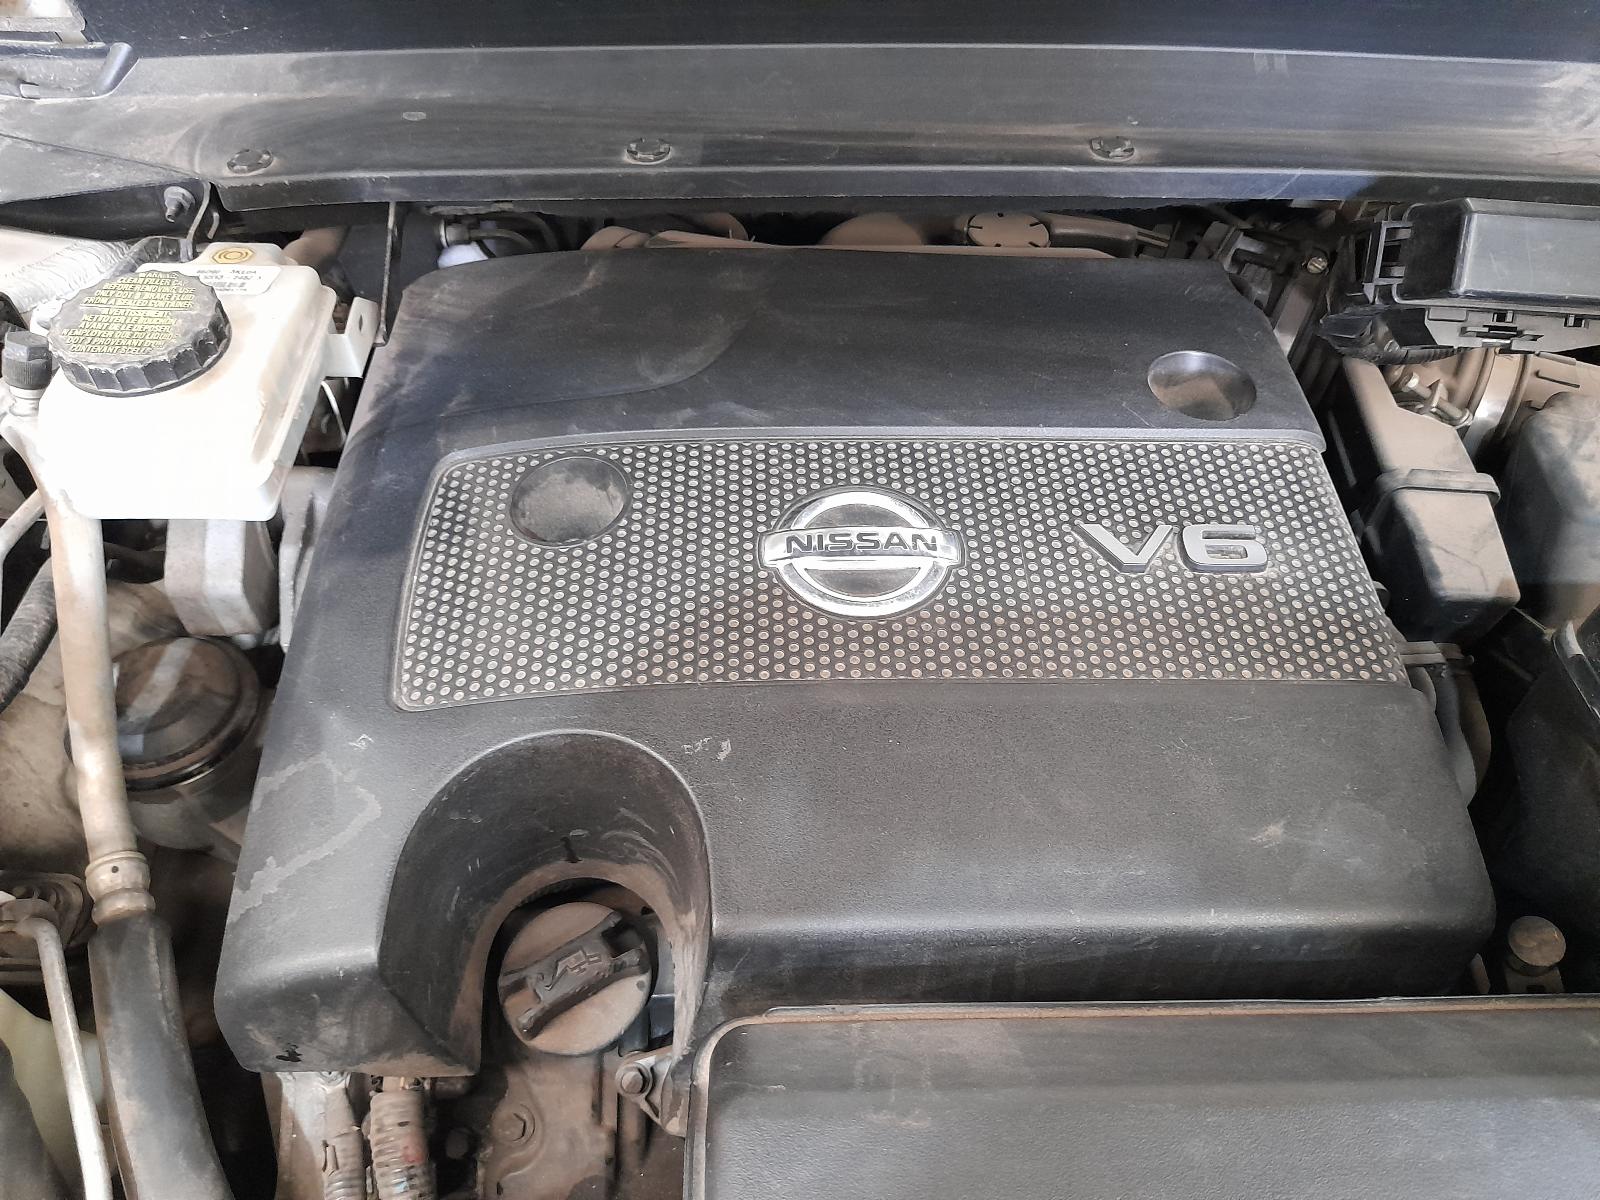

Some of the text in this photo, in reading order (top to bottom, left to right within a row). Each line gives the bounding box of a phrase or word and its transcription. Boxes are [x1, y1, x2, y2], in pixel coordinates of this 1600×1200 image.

[143, 278, 171, 286] FILLER
[83, 296, 108, 304] FROM
[785, 532, 938, 553] NISSAN
[1070, 523, 1267, 573] V6
